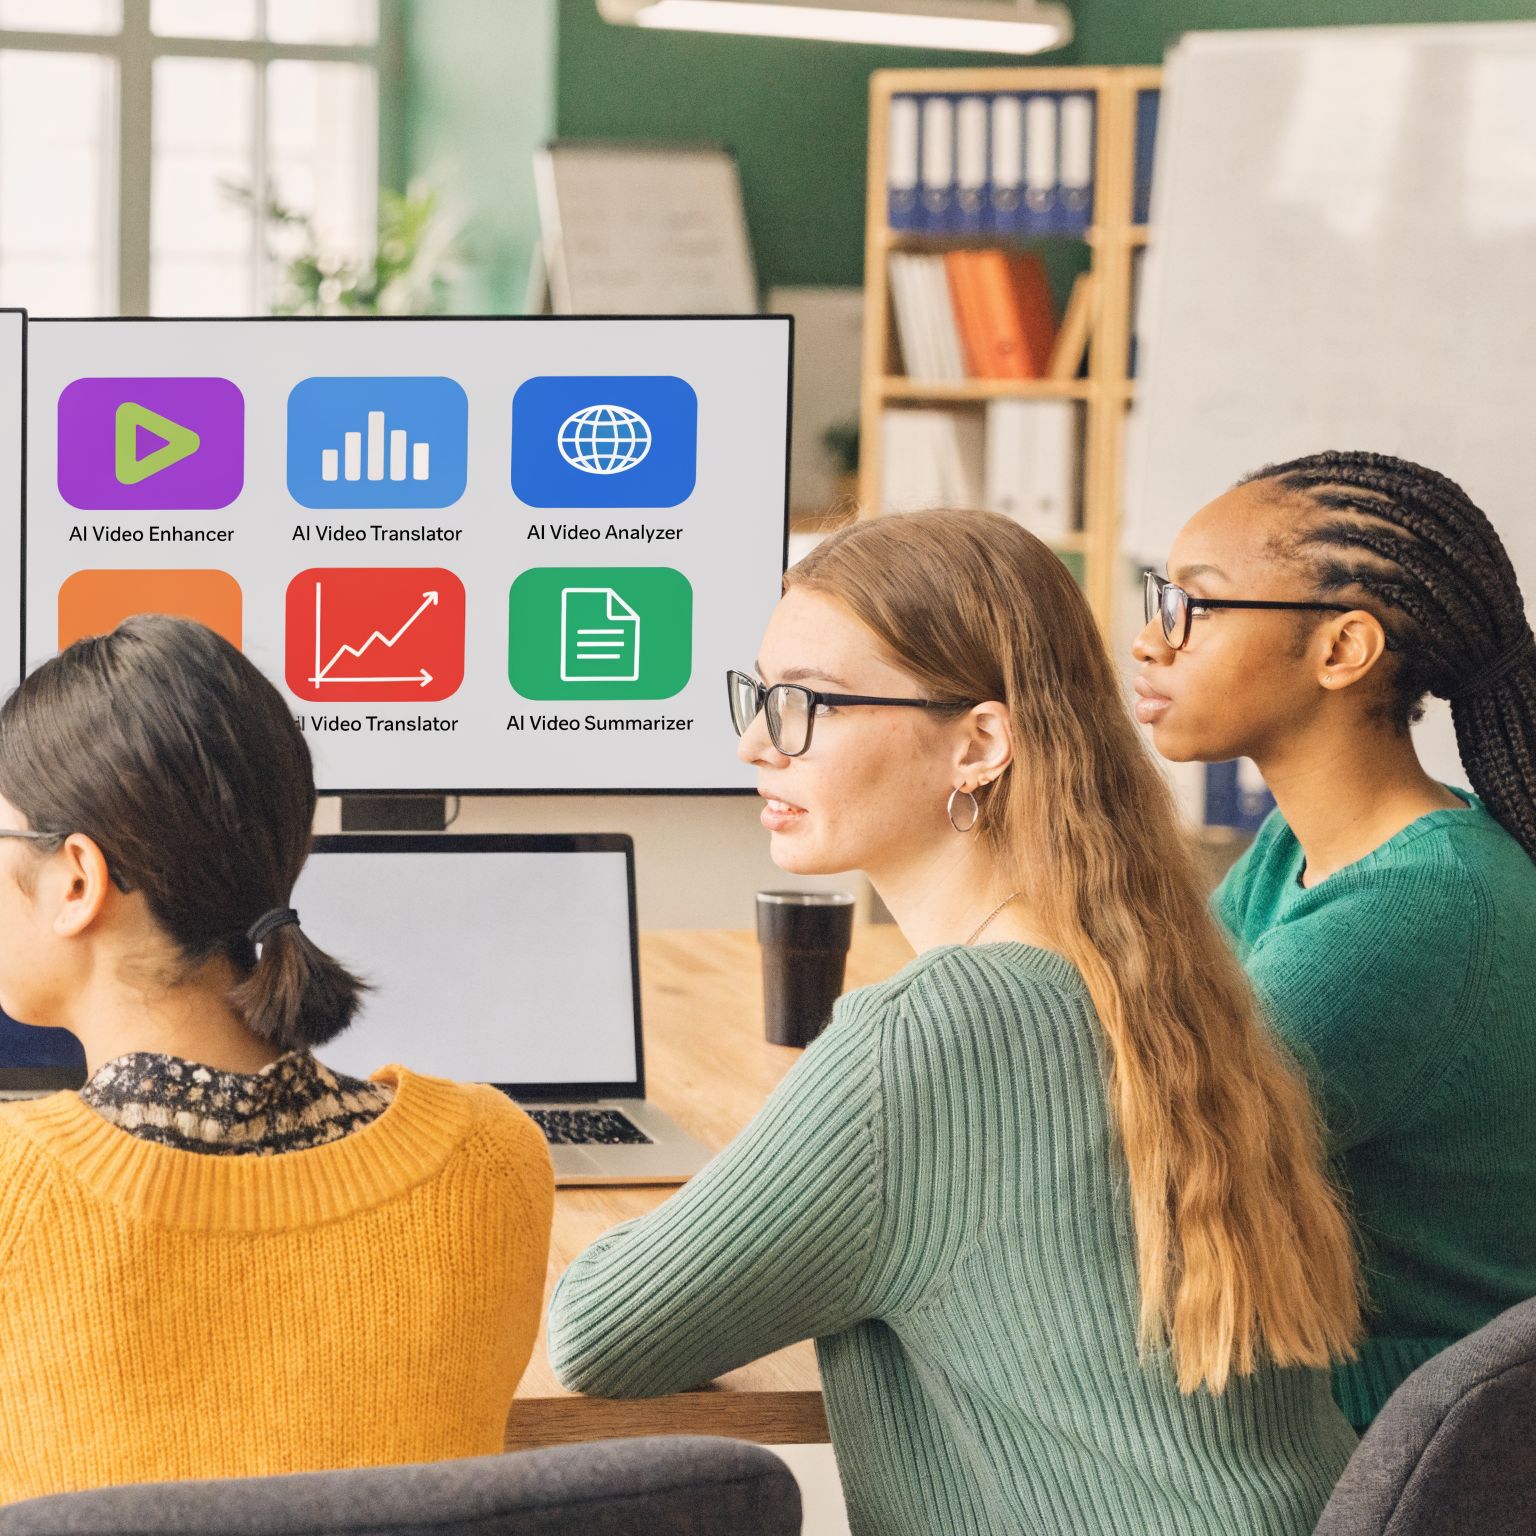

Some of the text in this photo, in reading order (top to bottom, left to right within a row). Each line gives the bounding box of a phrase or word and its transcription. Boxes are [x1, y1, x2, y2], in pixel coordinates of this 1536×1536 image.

[68, 525, 235, 542] AI Video Enhancer
[291, 524, 463, 542] AI Video Translator
[526, 523, 684, 544] AI Video Analyzer
[310, 715, 362, 732] Video
[365, 715, 459, 732] Translator
[506, 714, 694, 731] AI Video Summarizer
